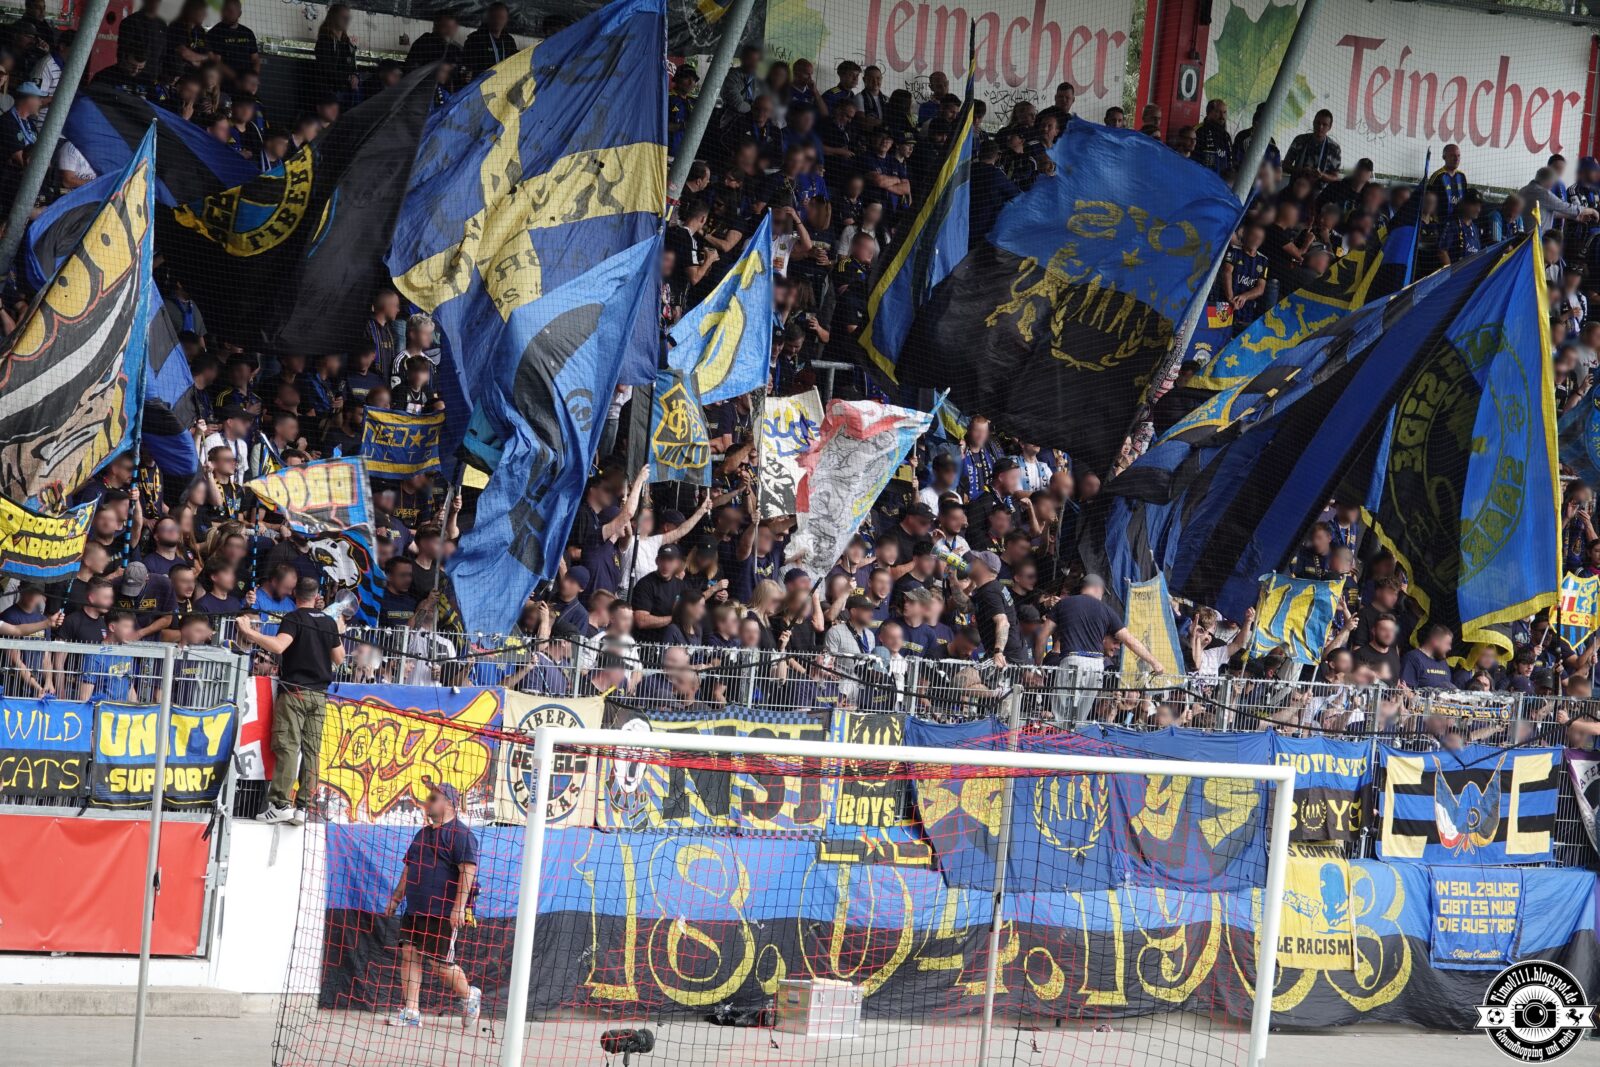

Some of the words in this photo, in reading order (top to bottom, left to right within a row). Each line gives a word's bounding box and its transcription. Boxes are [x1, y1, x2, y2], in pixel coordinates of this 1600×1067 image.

[1336, 34, 1581, 156] Teinacher
[4, 708, 82, 742] WILD
[100, 711, 231, 757] UNTY
[0, 756, 80, 790] CATS
[511, 749, 532, 770] PE
[840, 794, 896, 827] BOYS
[1435, 880, 1449, 896] IN
[1450, 880, 1520, 898] SALZBURG
[1440, 898, 1468, 915] GIBT
[1470, 899, 1489, 916] ES
[1491, 900, 1516, 916] NUR
[1437, 916, 1460, 933] DIE
[1277, 936, 1294, 954] LE
